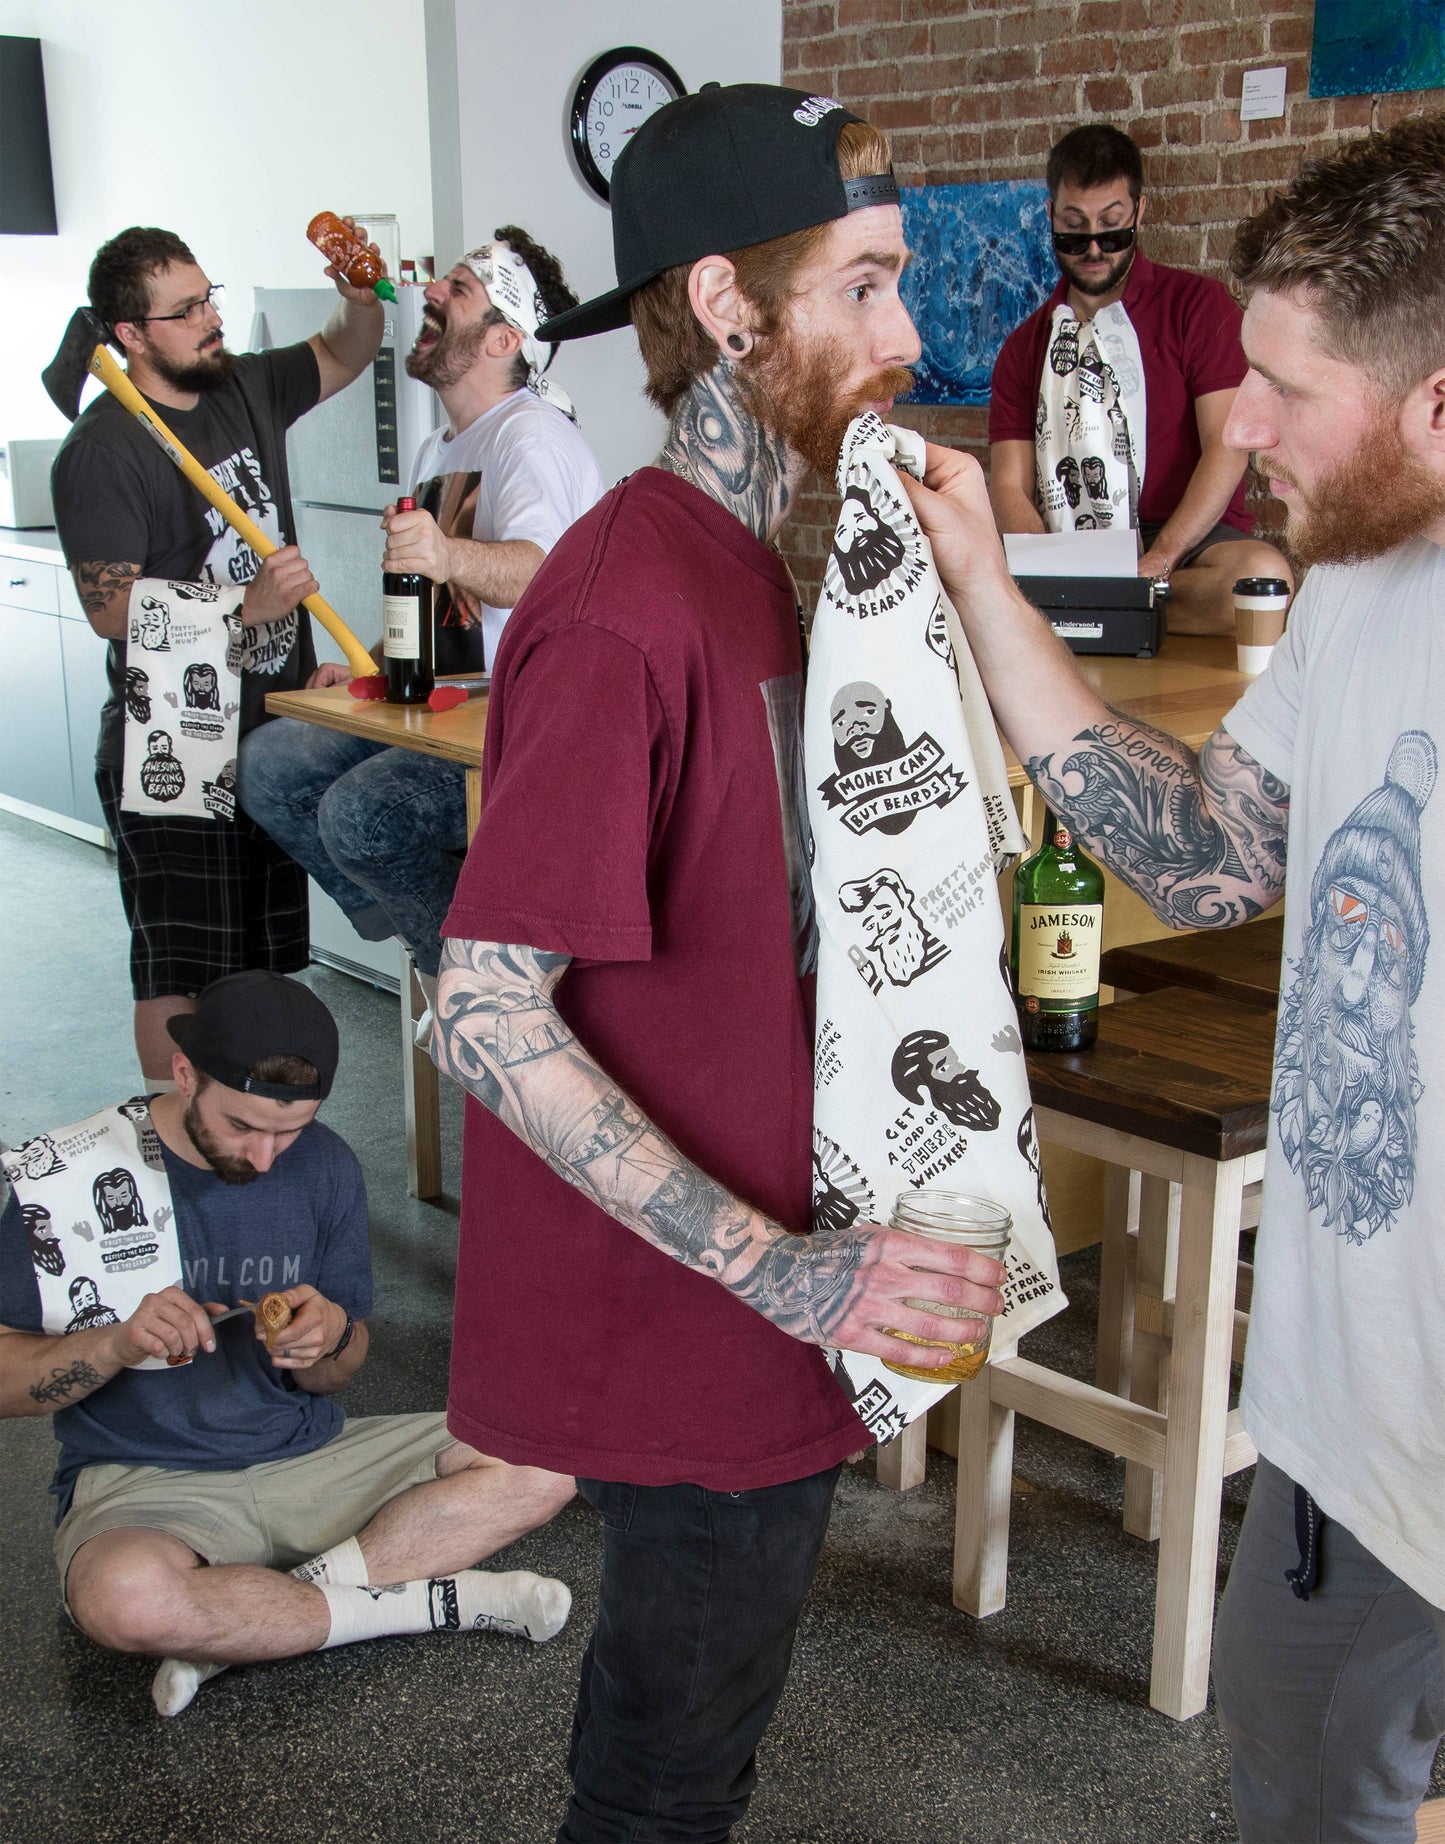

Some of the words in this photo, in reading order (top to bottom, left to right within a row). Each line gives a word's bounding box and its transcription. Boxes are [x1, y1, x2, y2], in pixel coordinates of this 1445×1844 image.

[611, 84, 621, 100] 11
[624, 78, 640, 94] 12
[598, 101, 614, 117] 10
[595, 121, 605, 137] 9
[599, 142, 611, 159] 8
[857, 413, 877, 434] EVEN
[857, 426, 878, 446] WITH
[184, 586, 208, 598] BEARDS
[858, 589, 906, 620] BEARD
[905, 559, 929, 594] MAN
[170, 624, 196, 632] PRETTY
[193, 627, 212, 636] BEARD
[143, 761, 180, 773] AWESOME
[838, 767, 893, 795] MONEY
[899, 743, 935, 775] CAN'T
[144, 772, 183, 784] FUCKING
[148, 784, 181, 796] BEARD
[210, 786, 234, 802] MONEY
[850, 802, 878, 828] BUY
[884, 781, 940, 811] BEARDS
[983, 796, 996, 818] YOUR
[992, 795, 1007, 821] LIFE?
[992, 820, 1006, 842] WITH
[919, 861, 967, 911] PRETTY
[929, 881, 968, 923] SWEET
[967, 852, 994, 885] BEAR
[945, 886, 984, 929] HUH?
[1030, 913, 1096, 930] JAMESON
[822, 1018, 834, 1036] ARE
[821, 1031, 842, 1056] DOING
[822, 1051, 837, 1070] YOUR
[823, 1059, 844, 1086] LIFE?
[886, 1107, 915, 1140] GET
[57, 1129, 90, 1149] PRETTY
[61, 1137, 89, 1154] SWEET
[89, 1126, 110, 1141] BEARD
[888, 1151, 899, 1166] A
[899, 1126, 924, 1153] LOAD
[925, 1111, 939, 1126] OF
[901, 1123, 957, 1174] THESE
[69, 1141, 97, 1158] HUH?
[909, 1135, 968, 1189] WHISKERS
[104, 1238, 122, 1246] TRUST
[135, 1232, 153, 1240] BEARD
[104, 1252, 126, 1261] RESPECT
[138, 1245, 156, 1253] BEARD
[132, 1257, 152, 1267] BEARD
[1015, 1262, 1031, 1274] TO
[1004, 1271, 1048, 1298] STROKE
[1001, 1300, 1015, 1318] MY
[1017, 1282, 1054, 1304] BEARD
[69, 1311, 116, 1332] AWESOME
[858, 1389, 883, 1418] AN'T
